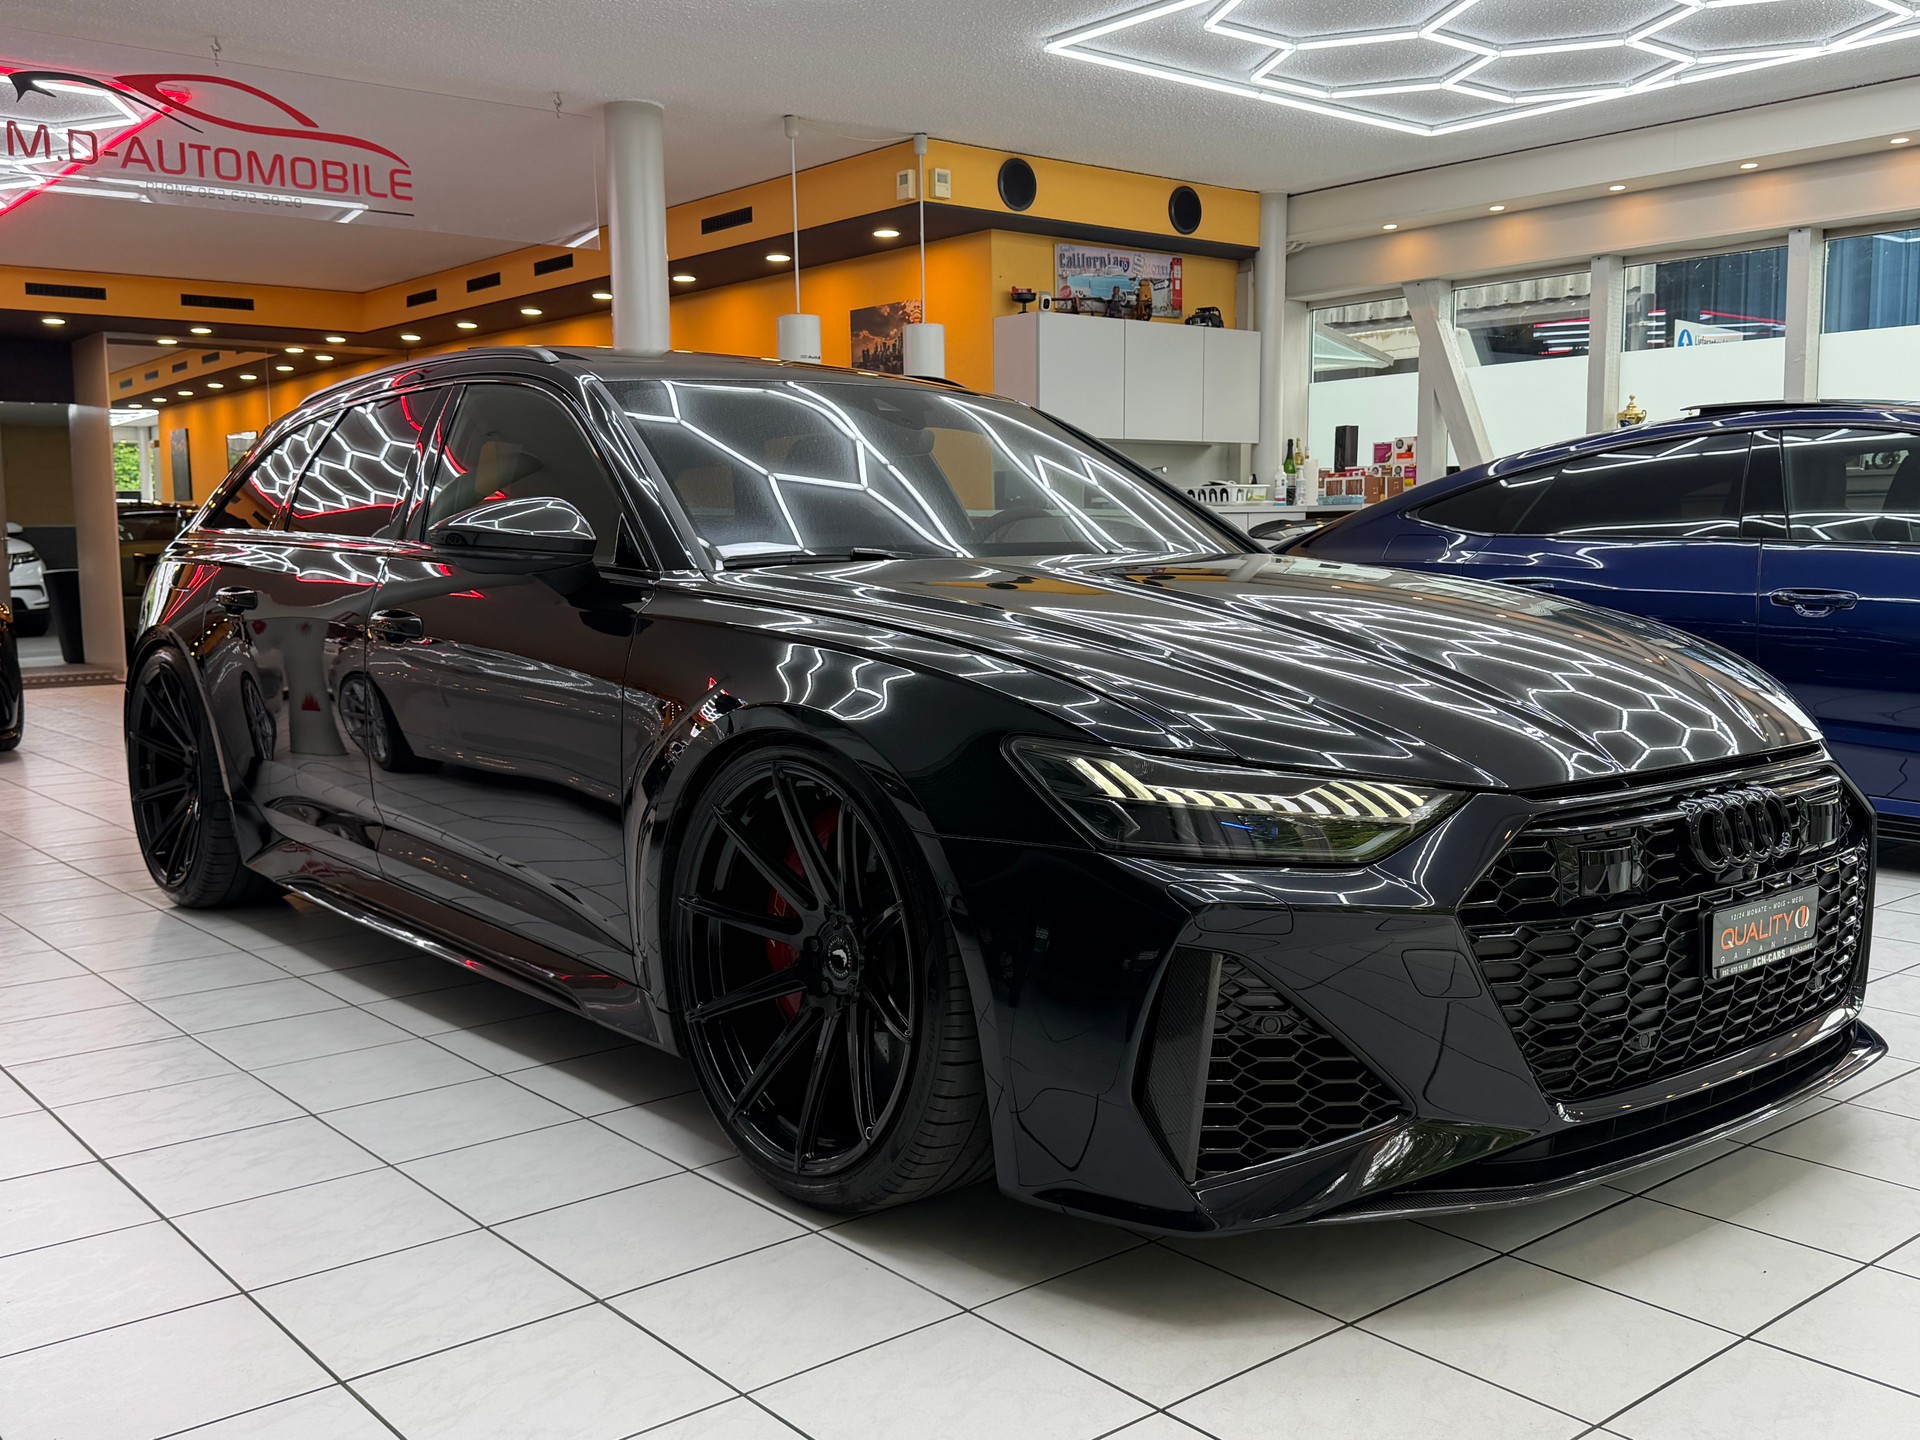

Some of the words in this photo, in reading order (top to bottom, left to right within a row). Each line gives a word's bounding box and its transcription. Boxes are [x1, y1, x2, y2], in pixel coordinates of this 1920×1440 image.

[6, 121, 413, 201] M.D-AUTOMOBILE
[146, 182, 193, 197] PHONE
[198, 187, 226, 200] 052
[231, 190, 257, 203] 672
[1059, 252, 1119, 268] California
[1747, 906, 1767, 916] MONATE
[1773, 900, 1786, 909] MOIS
[1791, 895, 1804, 904] MESI
[1721, 911, 1794, 949] QUALITY
[1752, 949, 1786, 967] ACN-CARS
